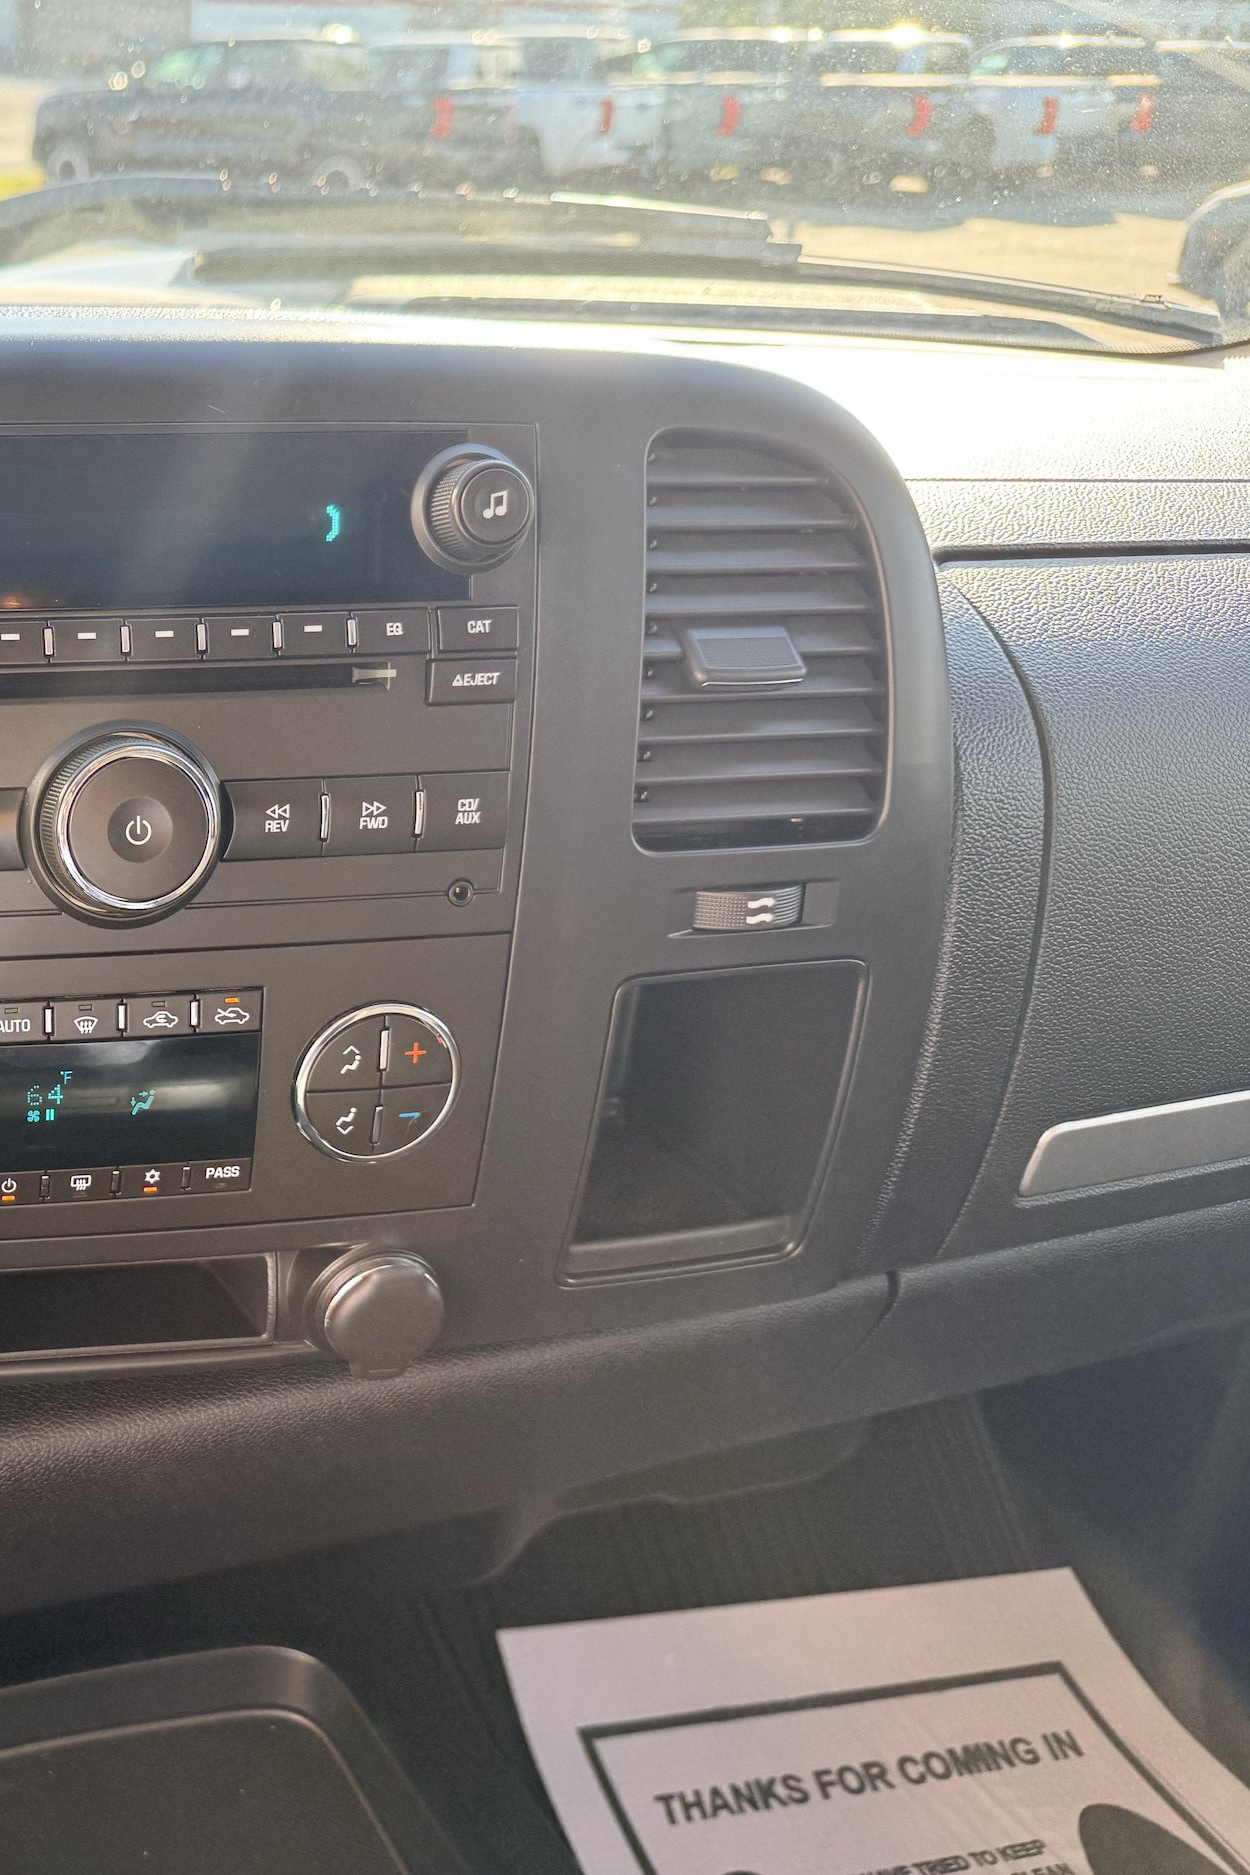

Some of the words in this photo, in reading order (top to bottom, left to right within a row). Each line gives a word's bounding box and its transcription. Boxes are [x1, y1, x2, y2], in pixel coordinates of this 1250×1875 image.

[386, 622, 404, 636] EQ
[467, 620, 492, 634] CAT
[463, 672, 501, 686] EJECT
[457, 799, 479, 812] CD/
[359, 816, 388, 830] FWD
[455, 811, 481, 825] AUX
[265, 820, 289, 834] REV
[26, 1084, 64, 1106] 64
[205, 1166, 240, 1179] PASS
[653, 1772, 810, 1826] THANKS
[812, 1761, 893, 1800] FOR
[897, 1736, 1041, 1785] COMING
[1042, 1730, 1085, 1762] IN
[968, 1850, 998, 1867] TO
[995, 1839, 1046, 1862] KEEP
